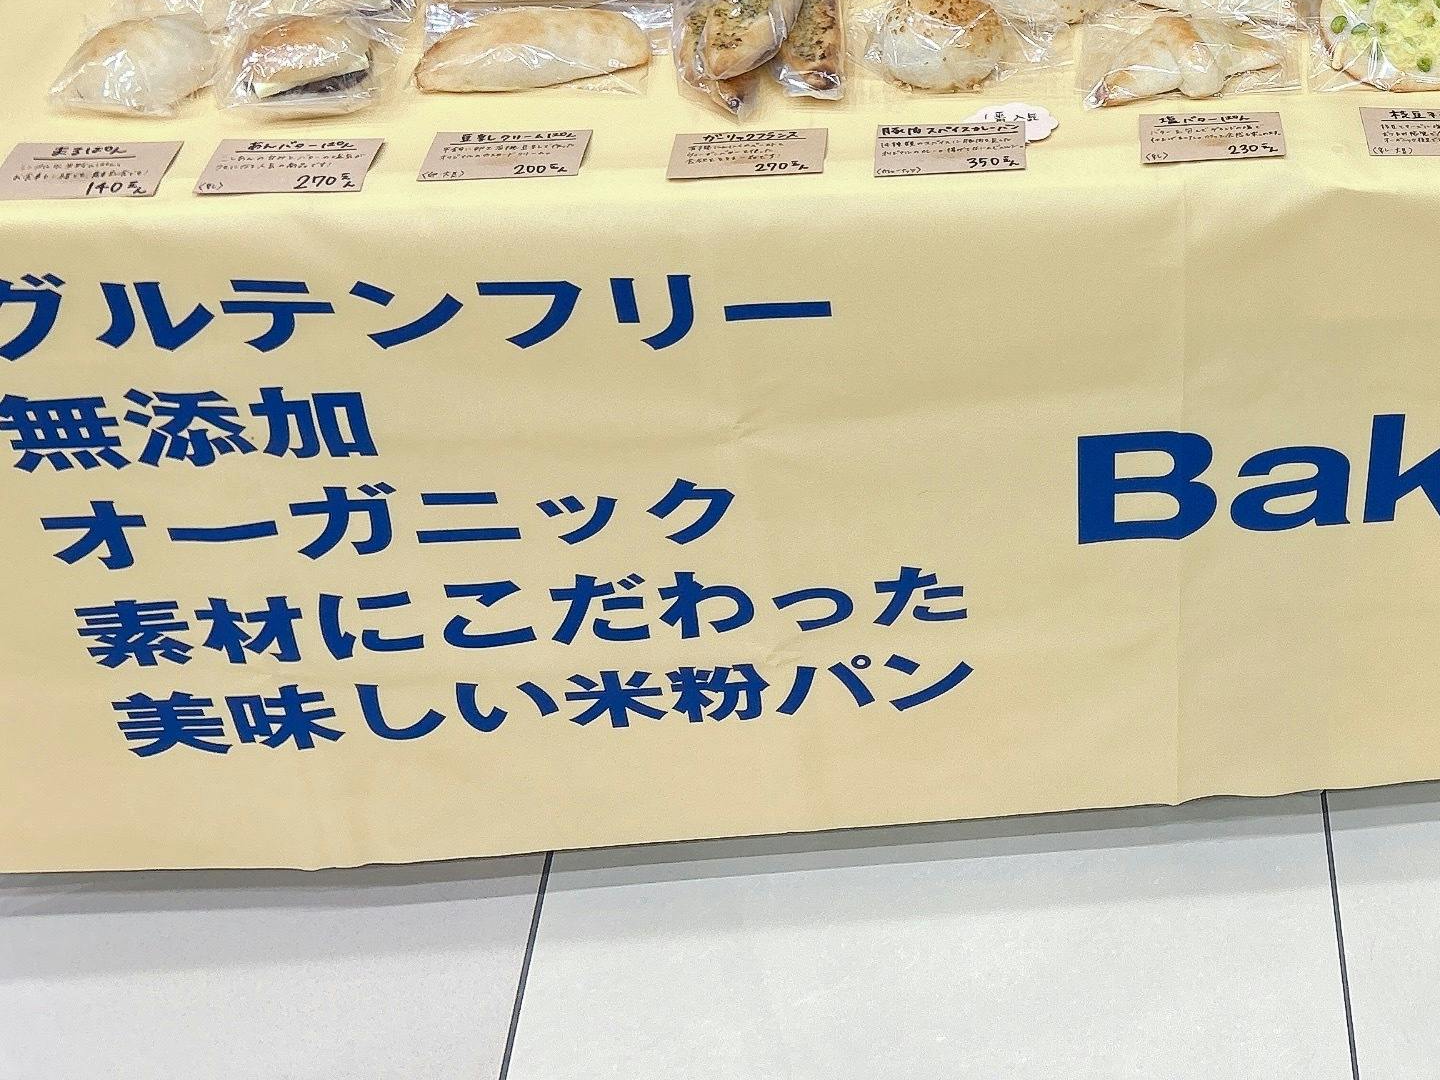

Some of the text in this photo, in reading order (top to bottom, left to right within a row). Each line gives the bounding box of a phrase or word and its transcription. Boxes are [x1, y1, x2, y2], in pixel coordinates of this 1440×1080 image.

[247, 140, 355, 151] あんバターぱん
[703, 131, 799, 142] ガーリックフランス
[0, 273, 833, 362] グルテンフリー
[0, 386, 379, 473] 無添加
[39, 478, 737, 571] オーガニック
[74, 565, 970, 668] 素材にこだわった
[111, 652, 976, 757] 美味しい米粉パン
